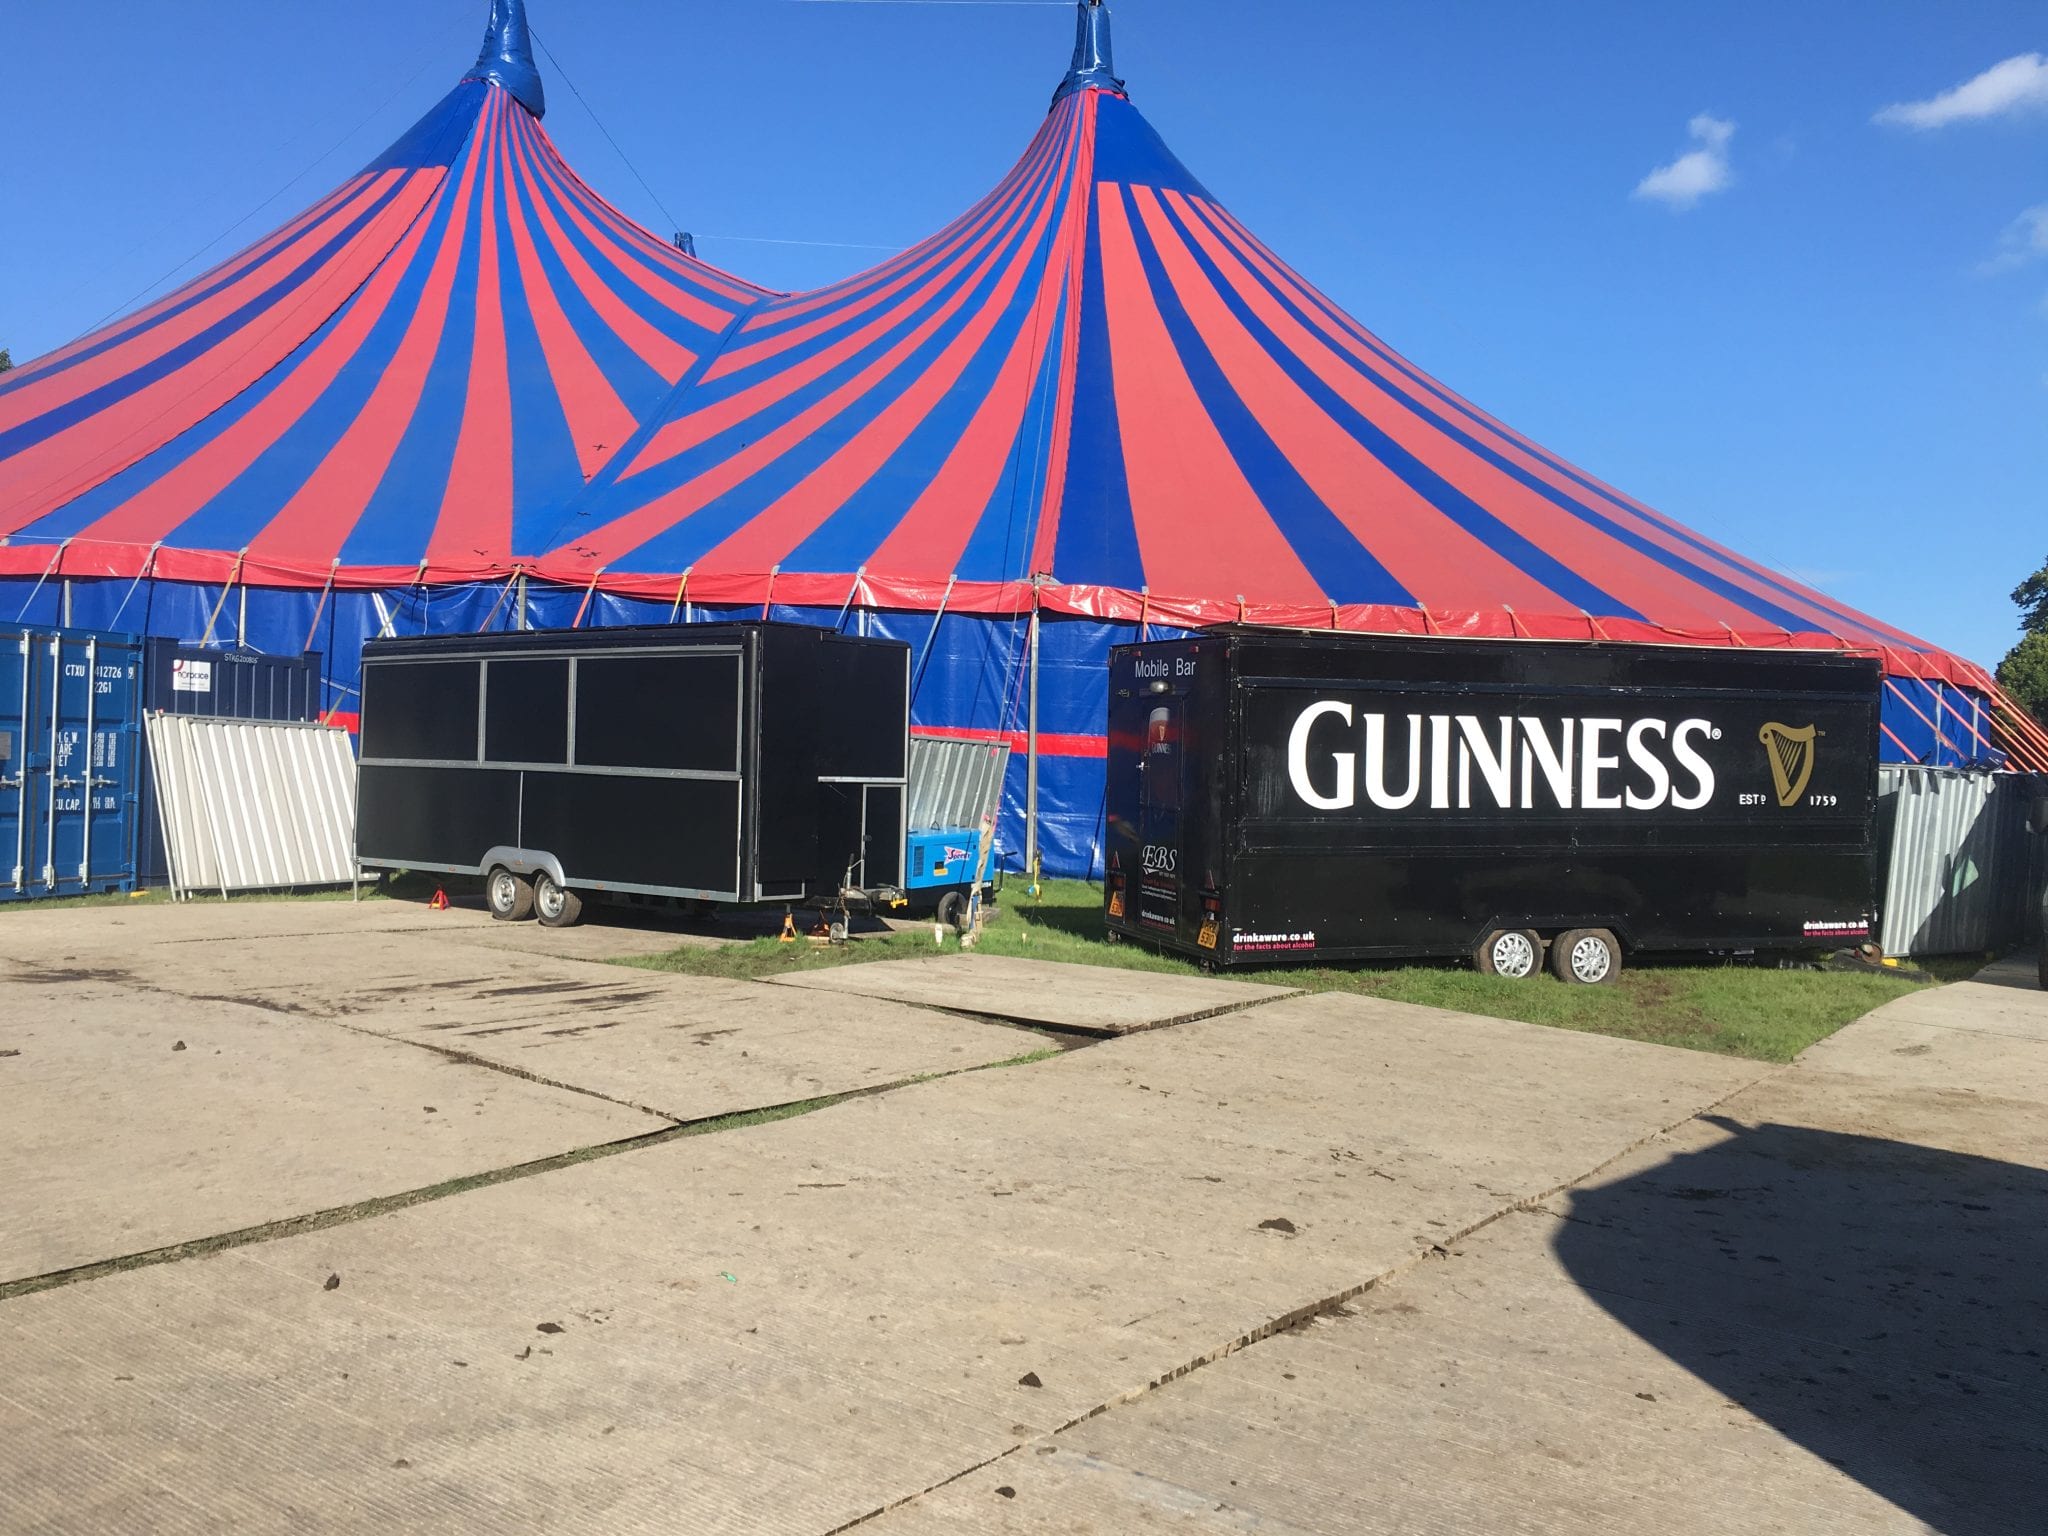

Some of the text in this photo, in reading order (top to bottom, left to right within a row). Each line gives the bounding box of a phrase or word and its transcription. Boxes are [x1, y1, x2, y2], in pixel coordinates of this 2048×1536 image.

[65, 664, 85, 677] CTXU
[94, 665, 122, 679] 412726
[1135, 658, 1196, 678] Mobile Bar
[94, 681, 112, 693] 22G1
[1809, 795, 1838, 807] 1759
[1142, 845, 1177, 872] EBS
[1233, 930, 1315, 943] drinkaware.co.uk
[1244, 943, 1255, 951] the
[1272, 942, 1291, 950] about
[1292, 941, 1315, 949] alcohol
